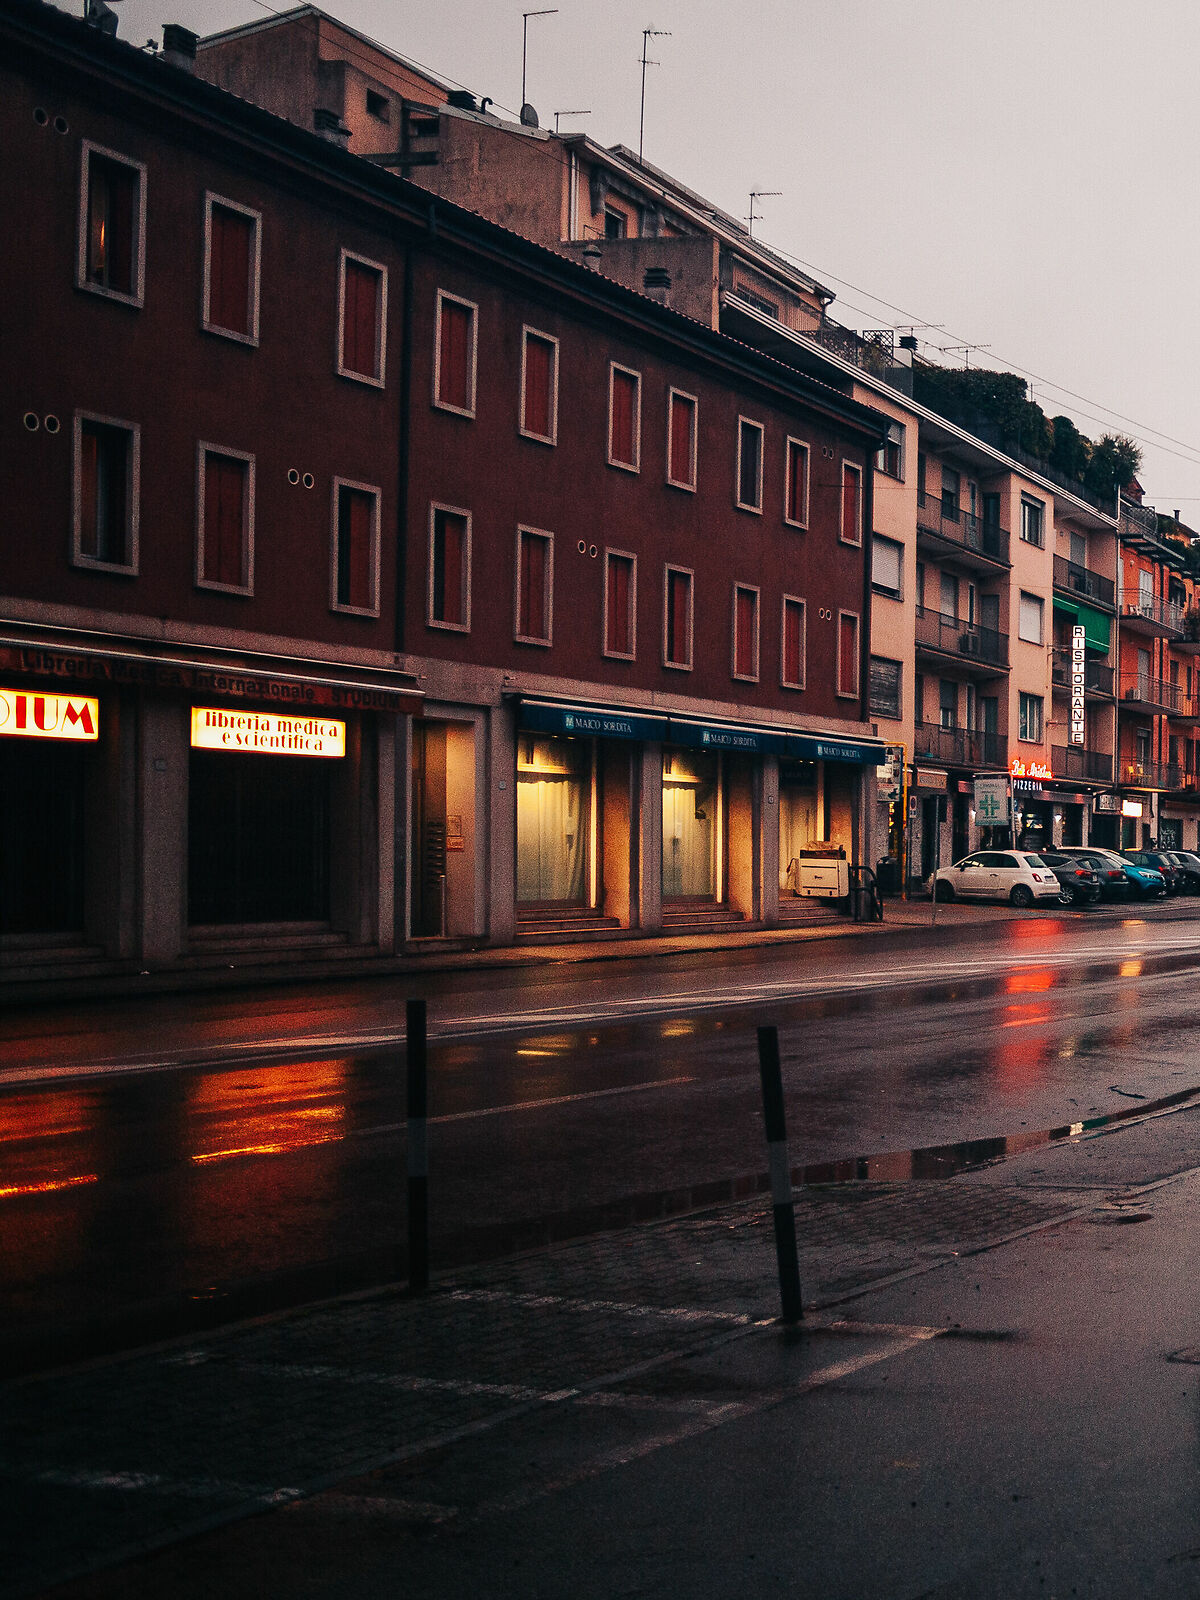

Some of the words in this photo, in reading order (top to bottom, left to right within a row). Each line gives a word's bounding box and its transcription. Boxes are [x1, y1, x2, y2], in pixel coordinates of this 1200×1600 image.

[21, 650, 107, 679] Libreria
[193, 670, 315, 700] Internazionale
[331, 689, 400, 710] STUDIUM
[1073, 627, 1083, 742] RISTORANTE
[206, 711, 270, 731] libreria
[278, 720, 338, 738] medica
[575, 718, 601, 730] MAICO
[222, 732, 231, 744] e
[236, 732, 323, 751] scientifica
[710, 733, 732, 744] MAICO
[1013, 779, 1043, 791] PIZZERIA
